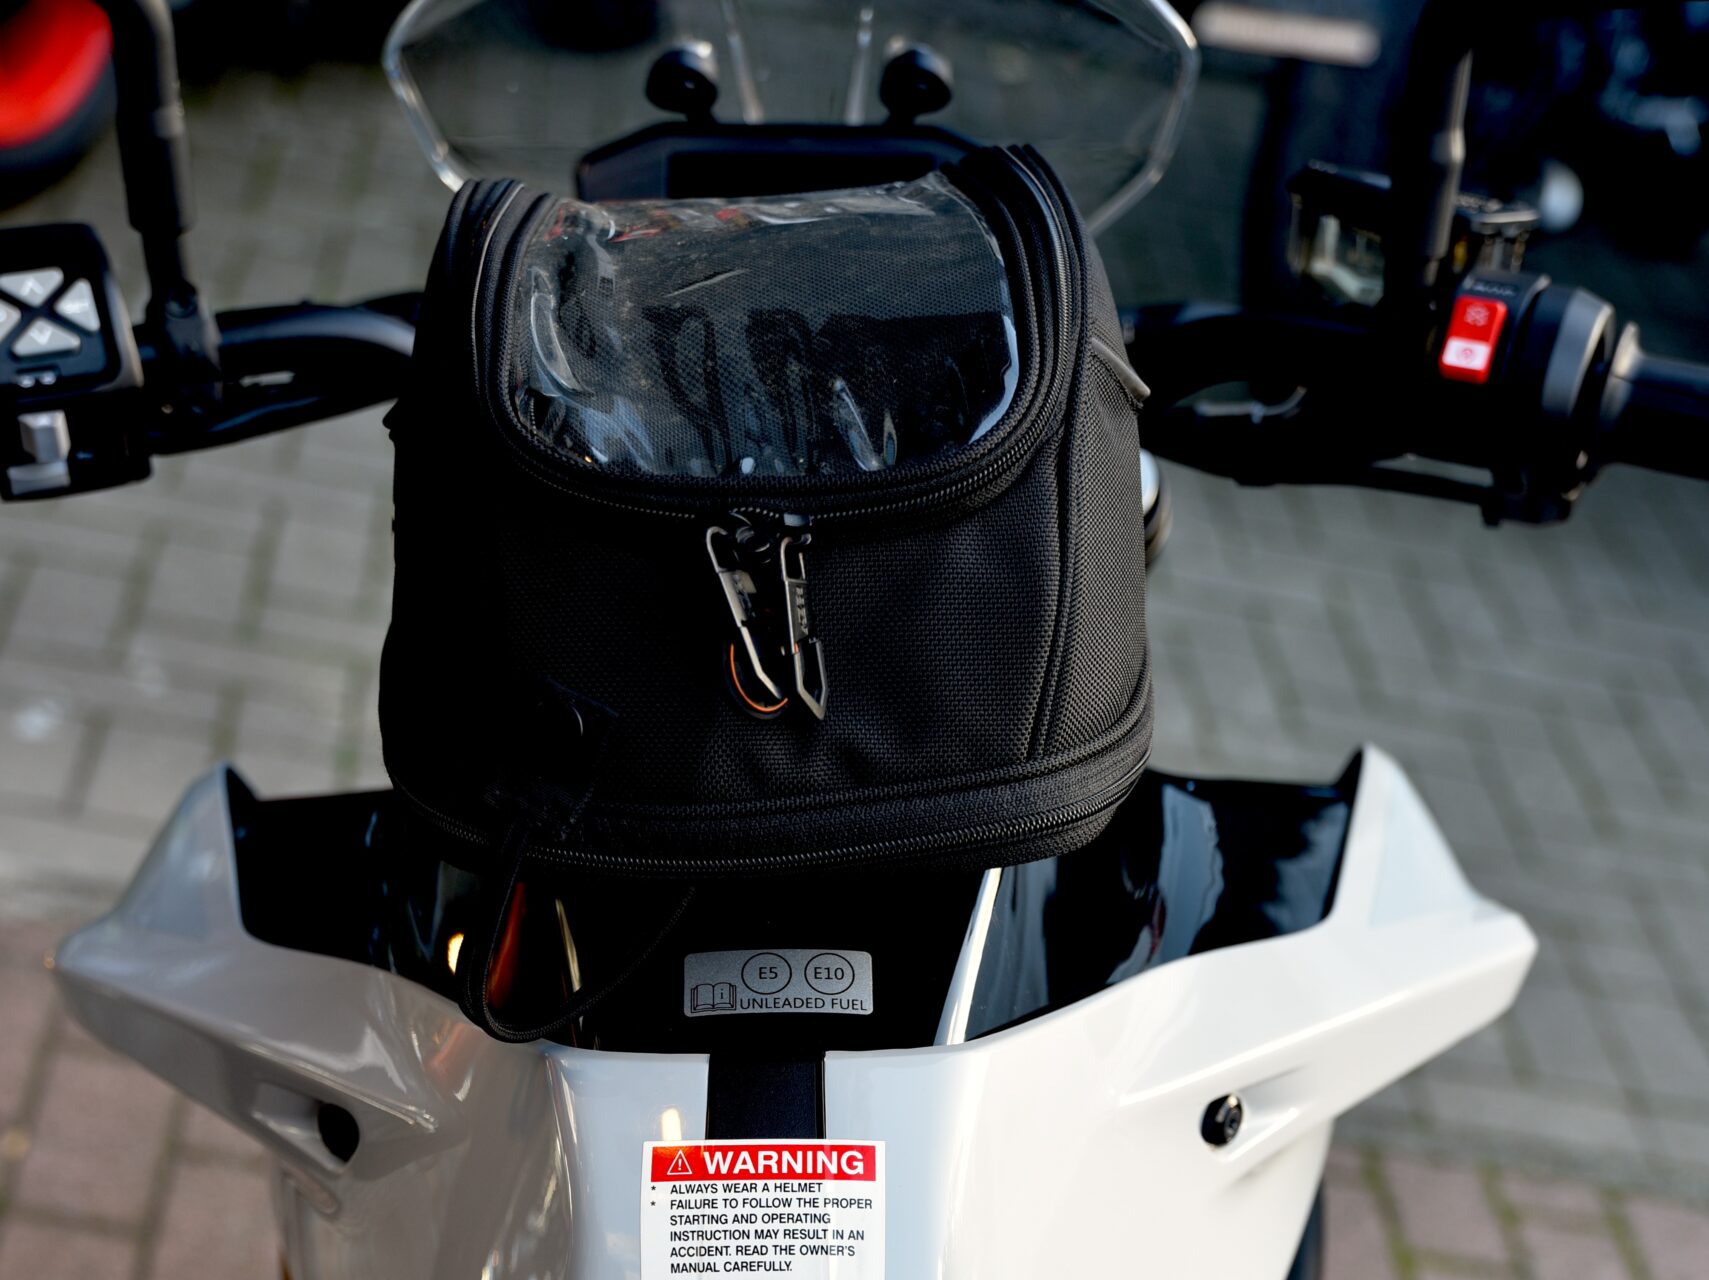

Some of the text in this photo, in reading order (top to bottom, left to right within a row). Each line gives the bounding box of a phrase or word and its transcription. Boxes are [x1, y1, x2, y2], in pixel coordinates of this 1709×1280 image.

[758, 967, 845, 981] E5 E10
[740, 997, 867, 1011] UNLEADED FUEL
[703, 1149, 865, 1176] WARNING
[670, 1182, 823, 1195] ALWAYS WEAR A HELMET
[670, 1197, 873, 1210] FAILURE TO FOLLOW THE PROPER
[669, 1213, 831, 1226] STARTING AND OPERATING
[670, 1229, 865, 1242] INSTRUCTION MAY RESULT IN AN
[670, 1244, 856, 1258] ACCIDENT. READ THE OWNER'S
[670, 1260, 793, 1274] MANUAL CAREFULLY.
